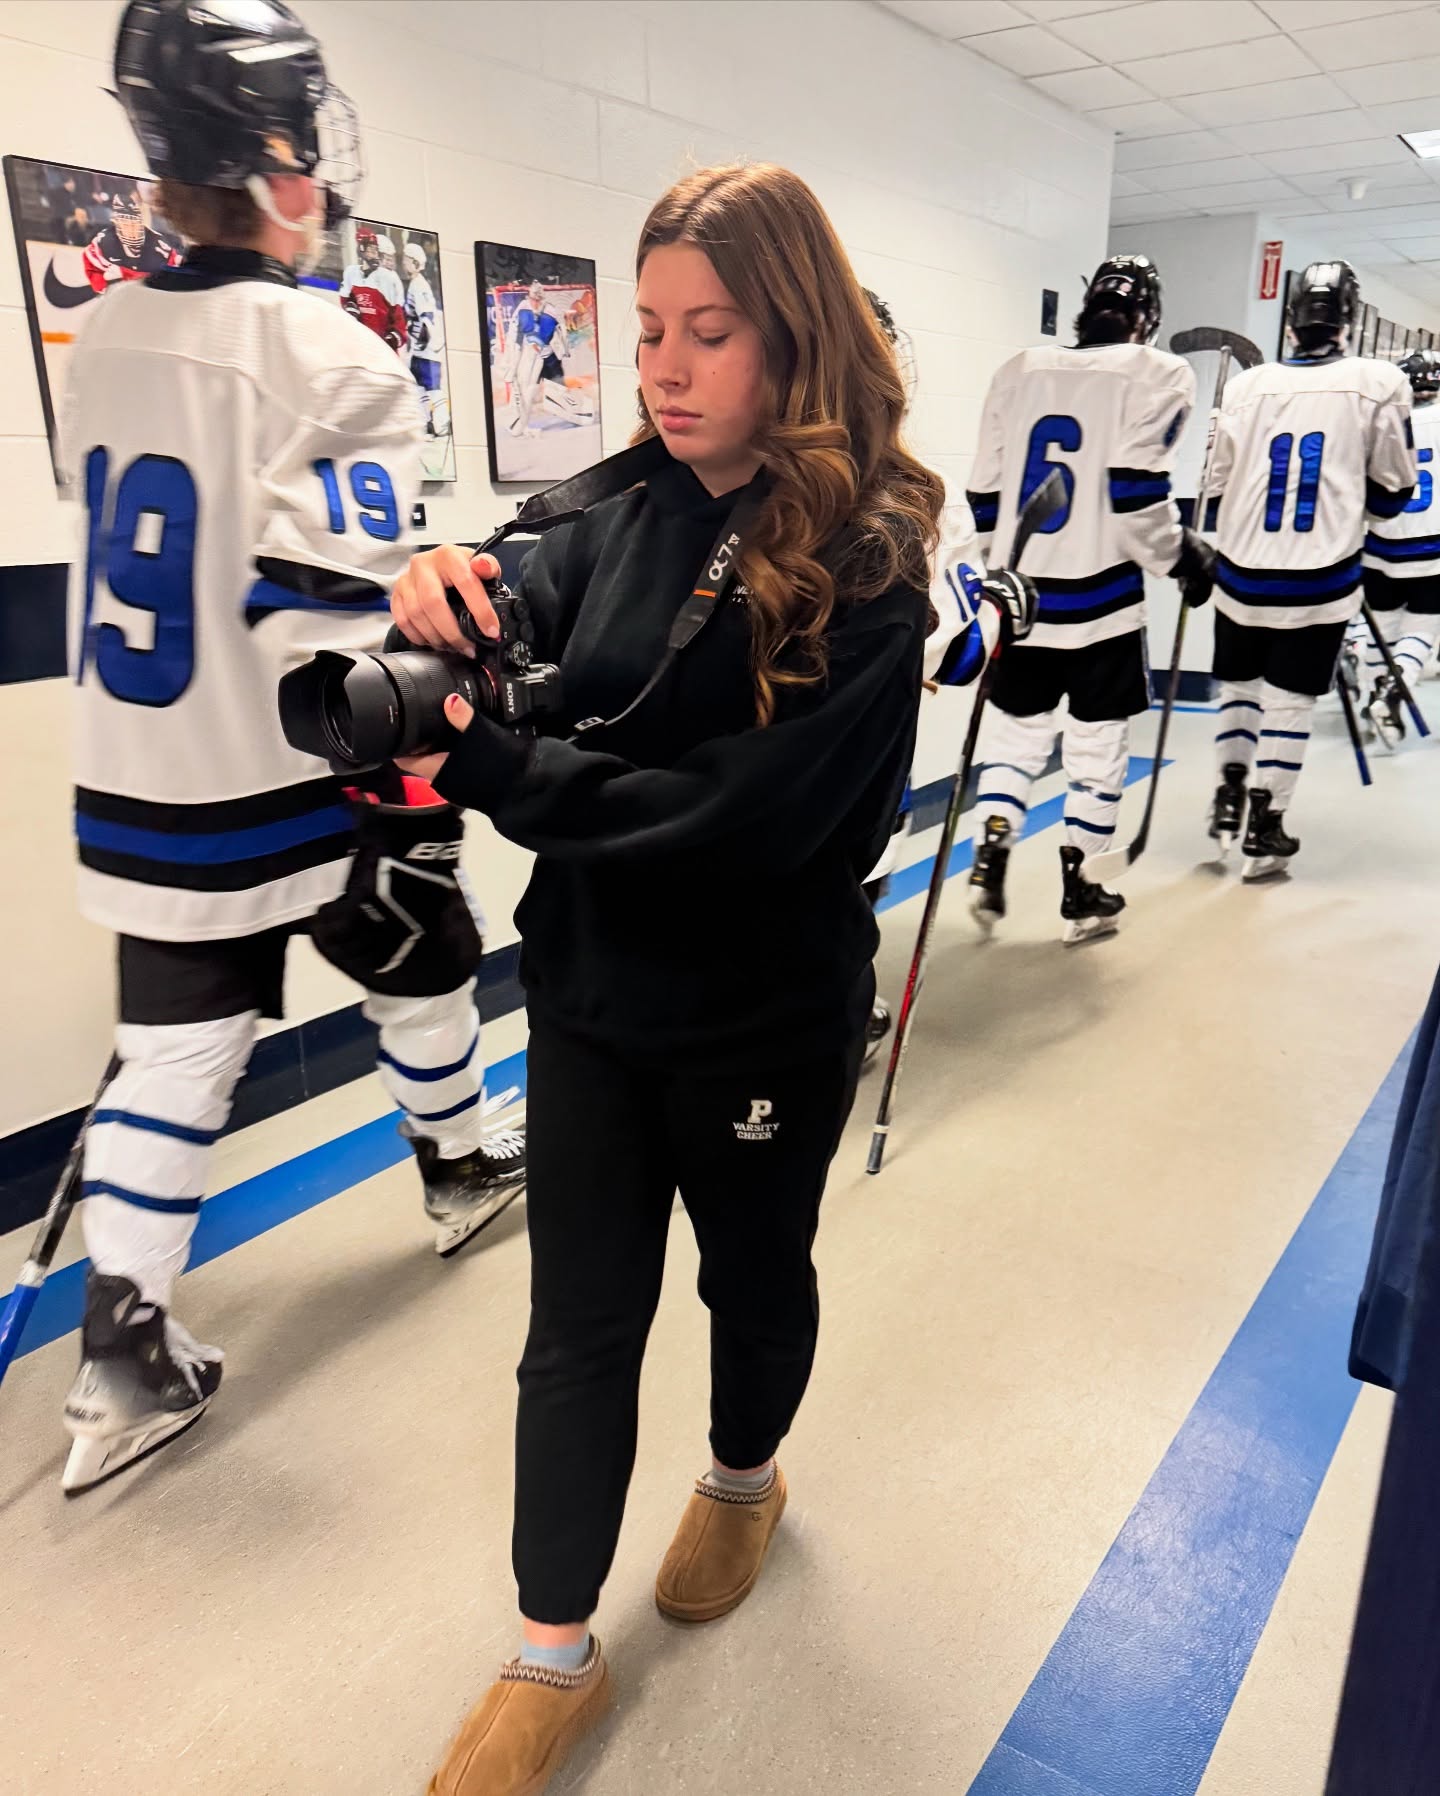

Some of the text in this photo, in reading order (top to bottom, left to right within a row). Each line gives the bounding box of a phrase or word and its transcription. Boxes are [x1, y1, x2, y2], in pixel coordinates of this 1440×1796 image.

[312, 457, 401, 542] 19
[1017, 414, 1083, 534] 6
[1263, 431, 1325, 533] 11
[76, 443, 198, 708] 19
[506, 682, 515, 715] SONY
[732, 1121, 780, 1132] VARSITY
[736, 1130, 773, 1140] CHEER
[747, 1099, 773, 1124] P
